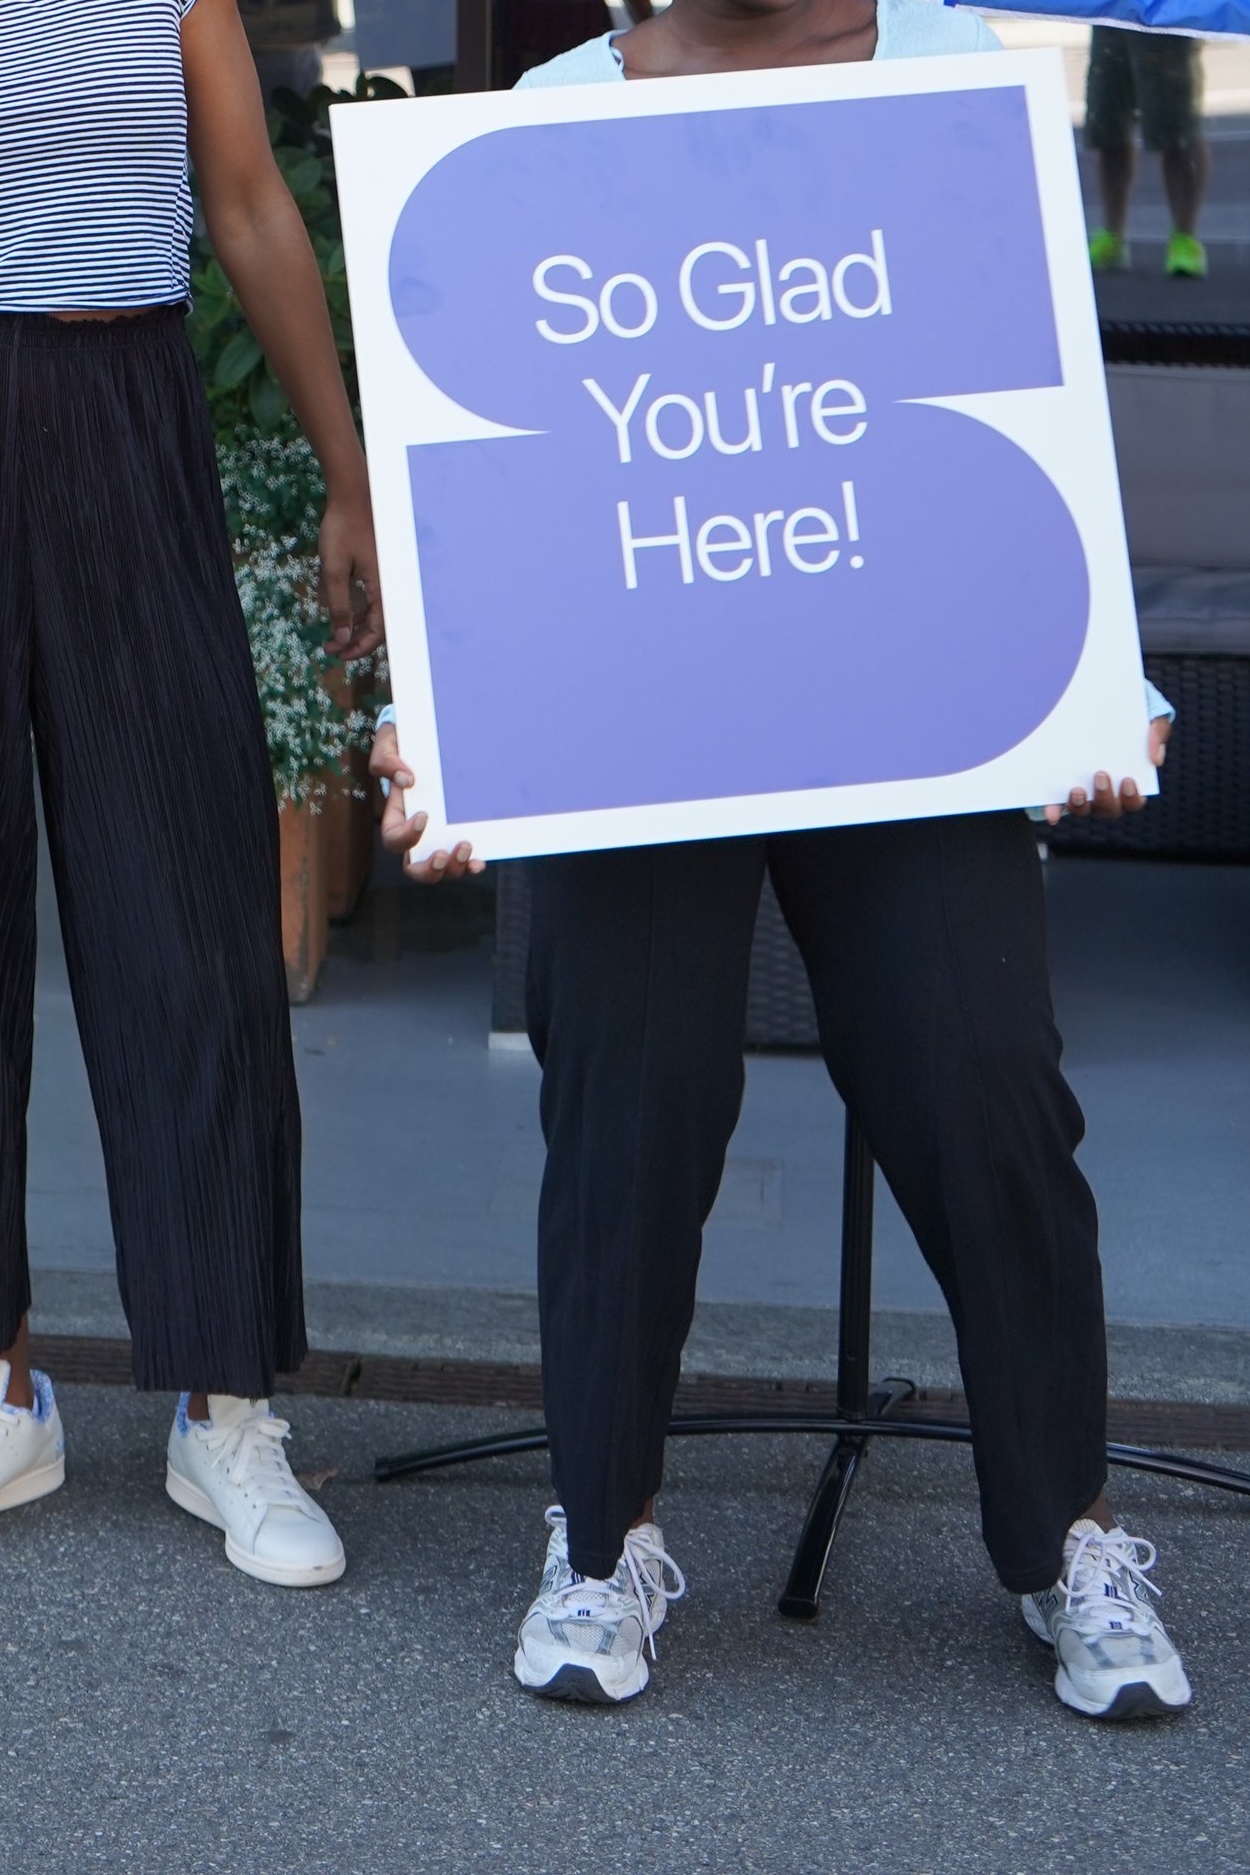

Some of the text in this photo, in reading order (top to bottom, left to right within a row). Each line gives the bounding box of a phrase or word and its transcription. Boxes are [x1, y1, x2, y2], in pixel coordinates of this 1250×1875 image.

[532, 229, 893, 345] So Glad
[581, 362, 868, 464] You're
[616, 480, 864, 590] Here!
